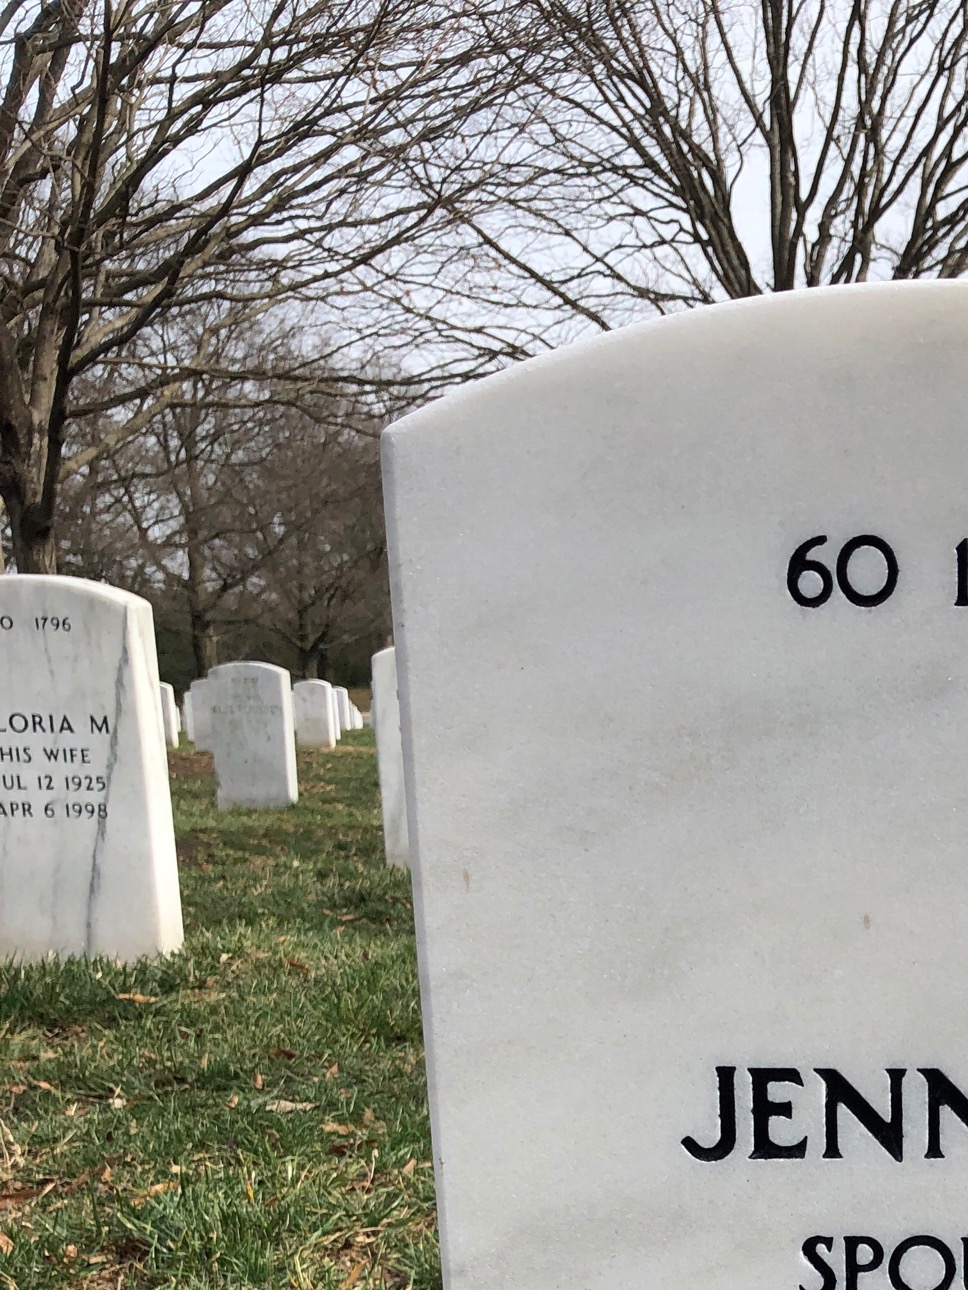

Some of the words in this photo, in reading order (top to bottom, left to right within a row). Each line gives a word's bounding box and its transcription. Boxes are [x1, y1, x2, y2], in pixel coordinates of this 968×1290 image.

[787, 534, 900, 609] 60
[35, 616, 72, 632] 1796
[90, 715, 110, 735] M
[0, 747, 32, 764] HIS
[43, 747, 91, 764] WIFE
[37, 775, 55, 791] 12
[65, 775, 106, 792] 1925
[0, 802, 33, 818] APR
[44, 802, 55, 819] 6
[65, 802, 108, 819] 1998
